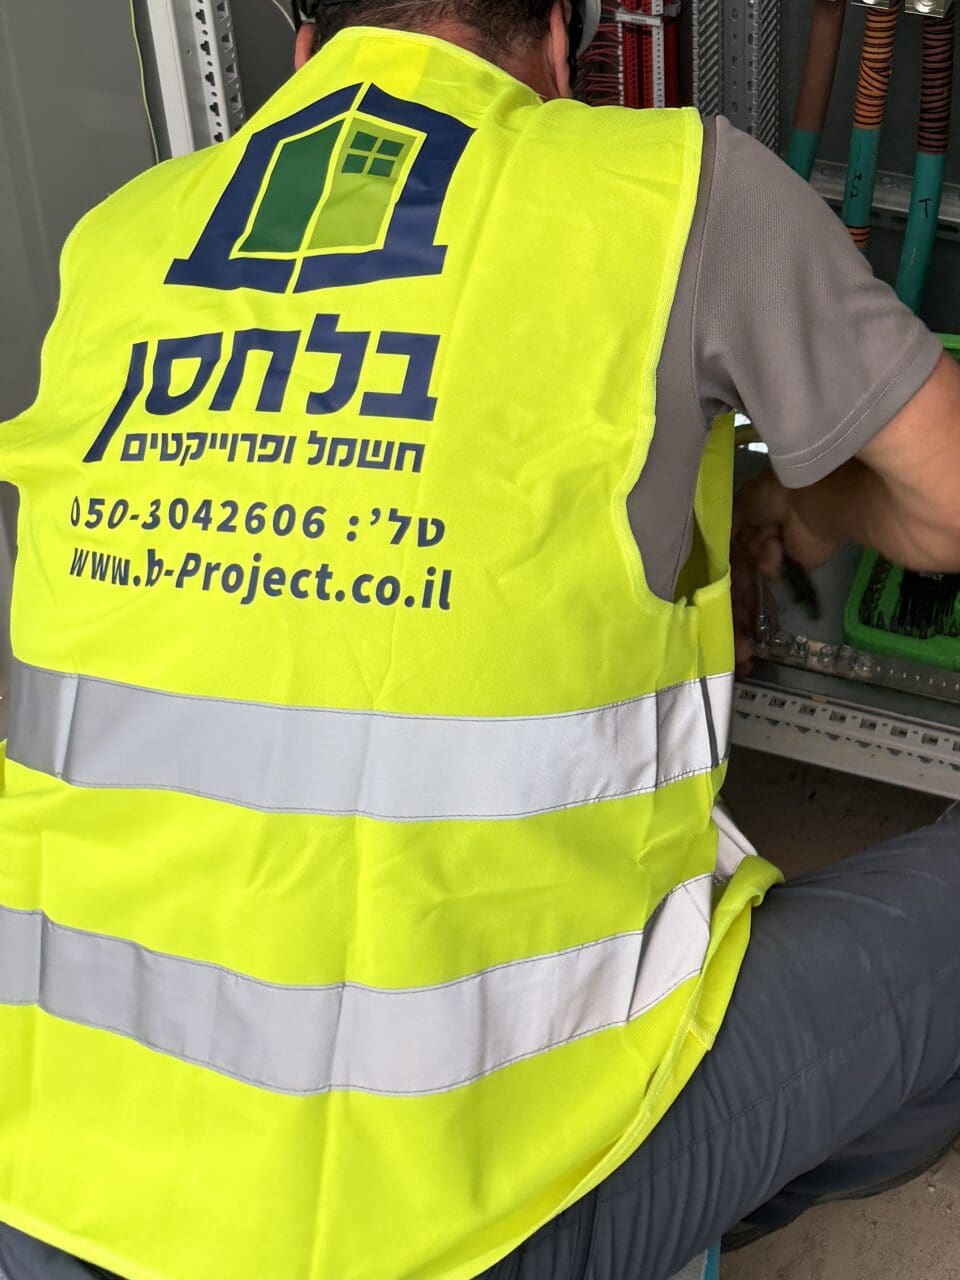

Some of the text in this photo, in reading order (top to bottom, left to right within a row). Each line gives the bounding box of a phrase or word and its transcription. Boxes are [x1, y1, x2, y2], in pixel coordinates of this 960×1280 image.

[918, 197, 932, 219] T
[82, 312, 441, 464] בלחסן
[119, 429, 426, 473] חשמל ופרוייקטים
[69, 495, 328, 540] 050-3042606
[68, 546, 453, 611] www.b-Project.co.il
